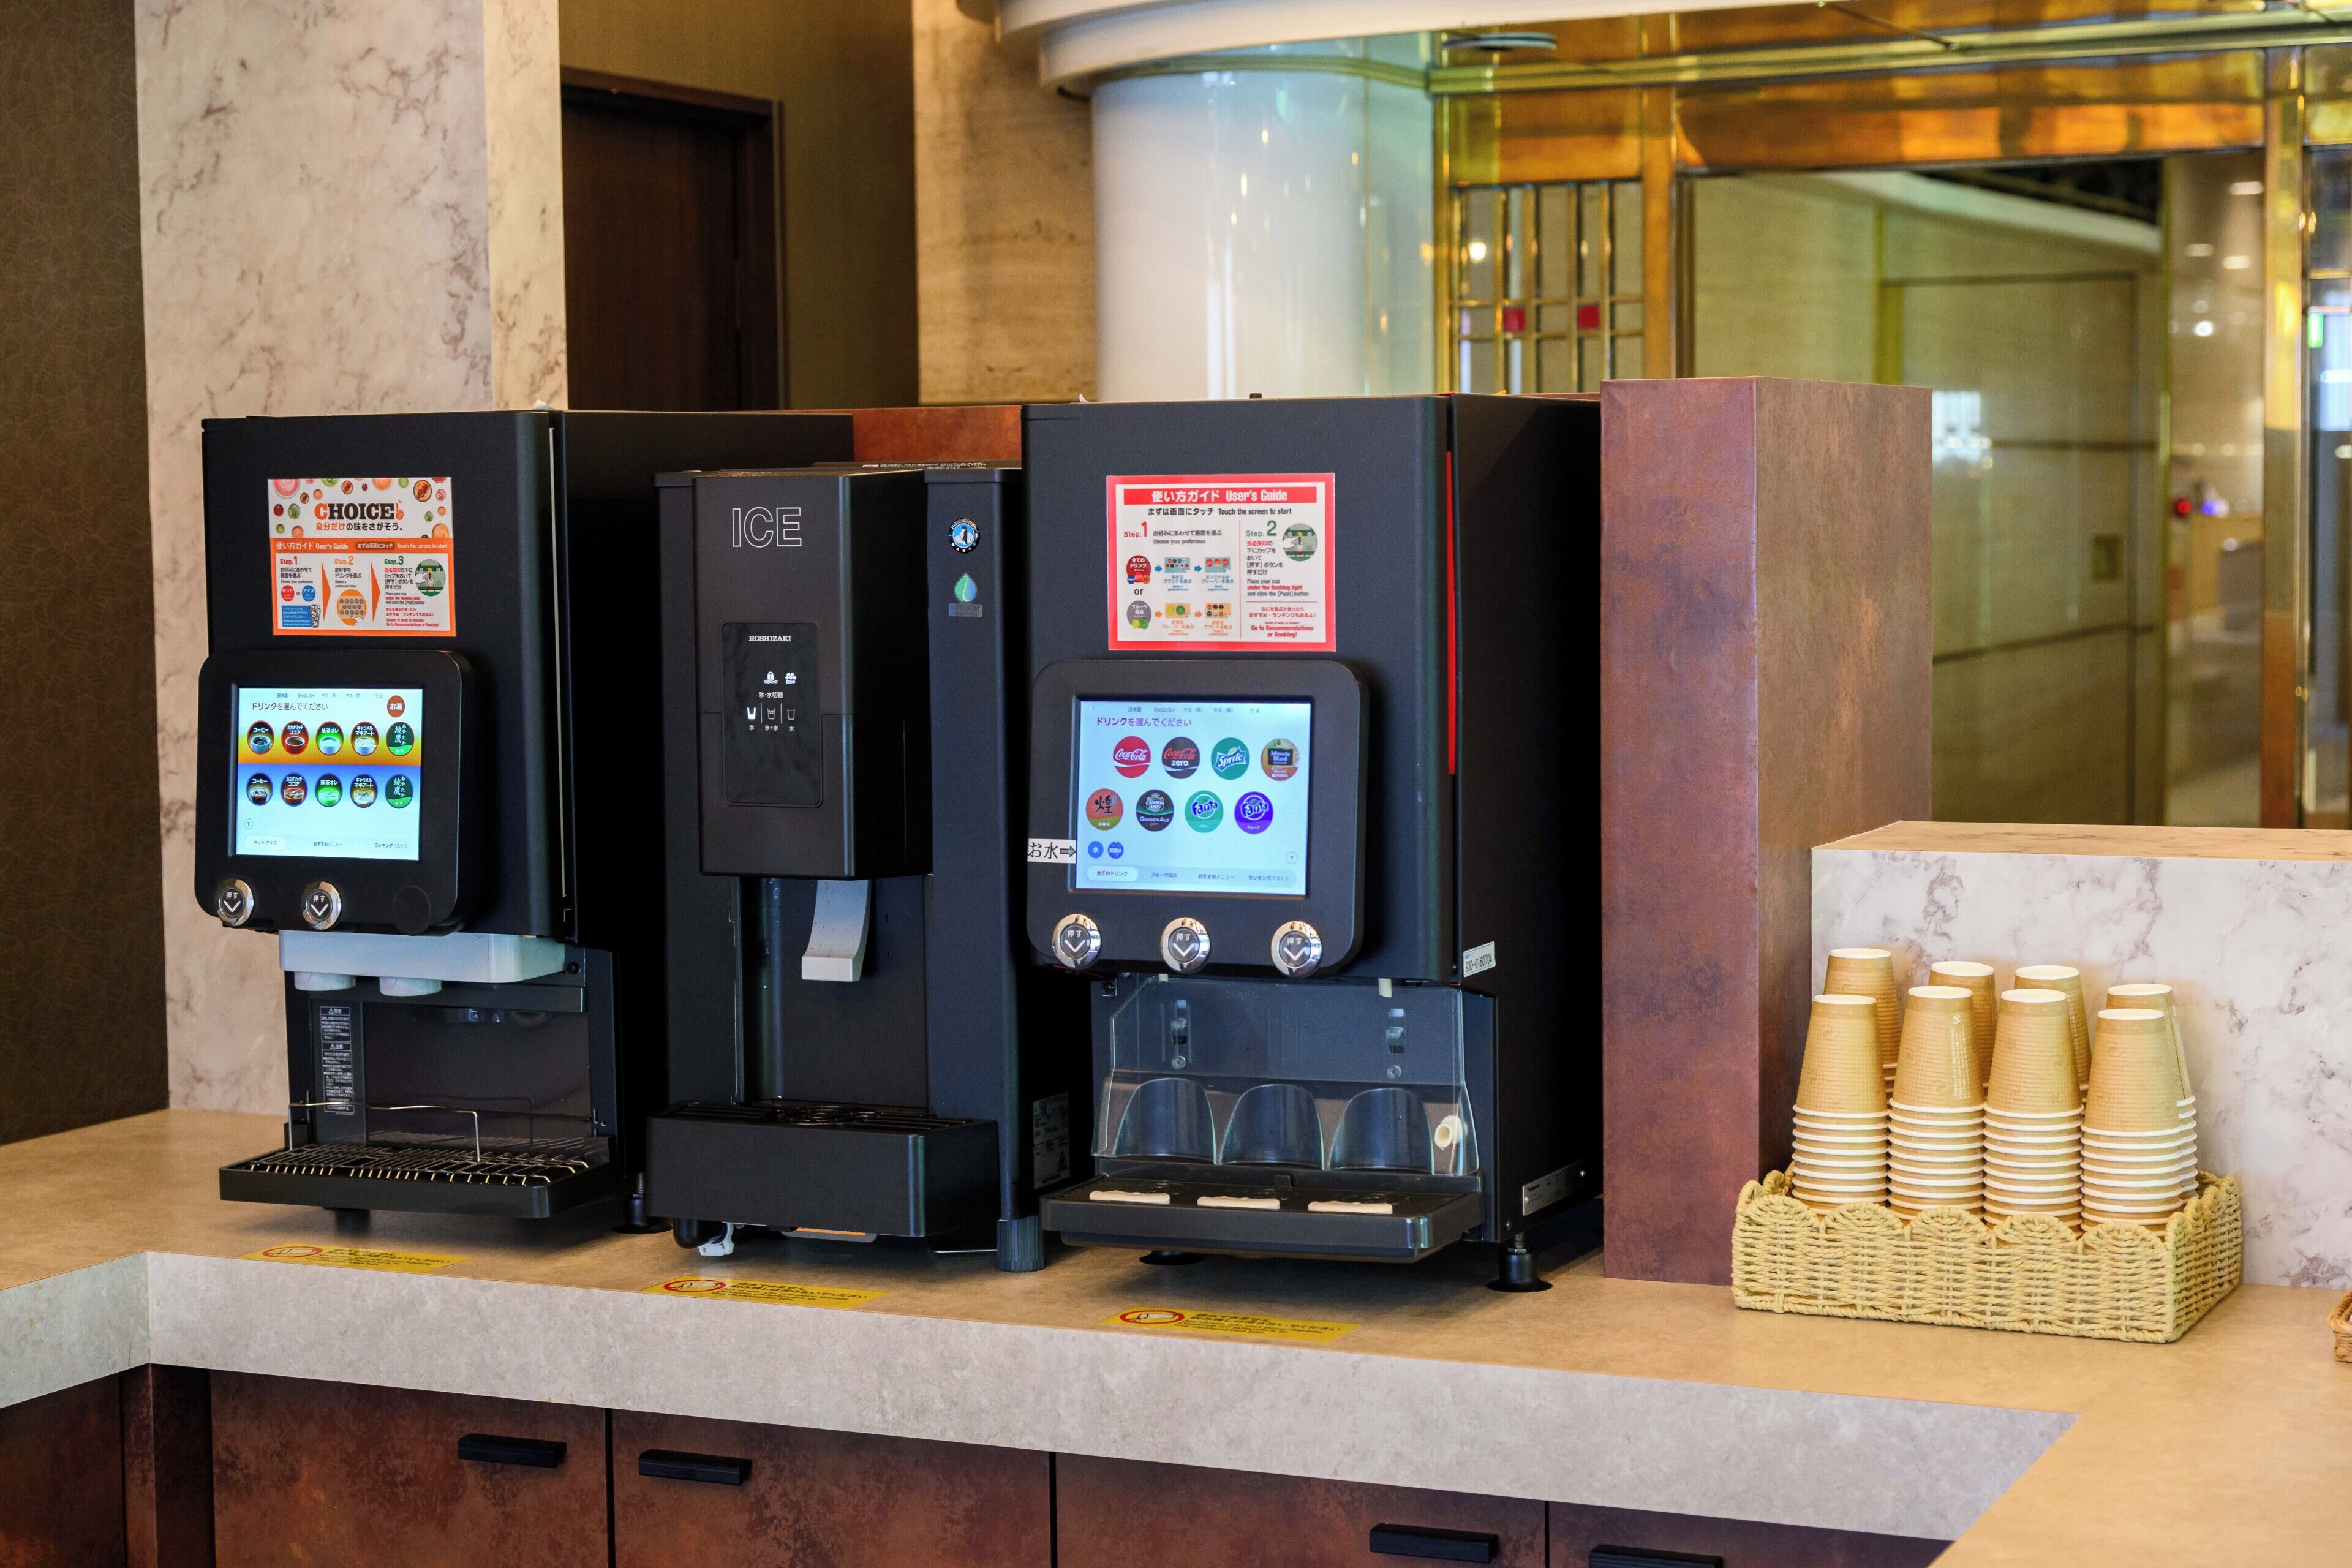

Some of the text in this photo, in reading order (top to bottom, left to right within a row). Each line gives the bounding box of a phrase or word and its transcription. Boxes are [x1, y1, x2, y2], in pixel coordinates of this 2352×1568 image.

[1152, 489, 1287, 503] 使い方ガイド User's Guide
[314, 503, 394, 520] CHOICE
[316, 522, 402, 531] 自分だけの味をさがそう。
[732, 506, 802, 548] ICE
[276, 541, 314, 550] 使い方ガイド
[1096, 717, 1192, 727] ドリンクを選んでください
[1217, 752, 1244, 768] Sprite
[1191, 799, 1219, 817] Fanta
[1240, 800, 1269, 818] Fanta
[1028, 842, 1059, 860] お水
[1067, 929, 1083, 938] 押す
[1175, 933, 1192, 941] 押す
[1286, 937, 1303, 946] 押す
